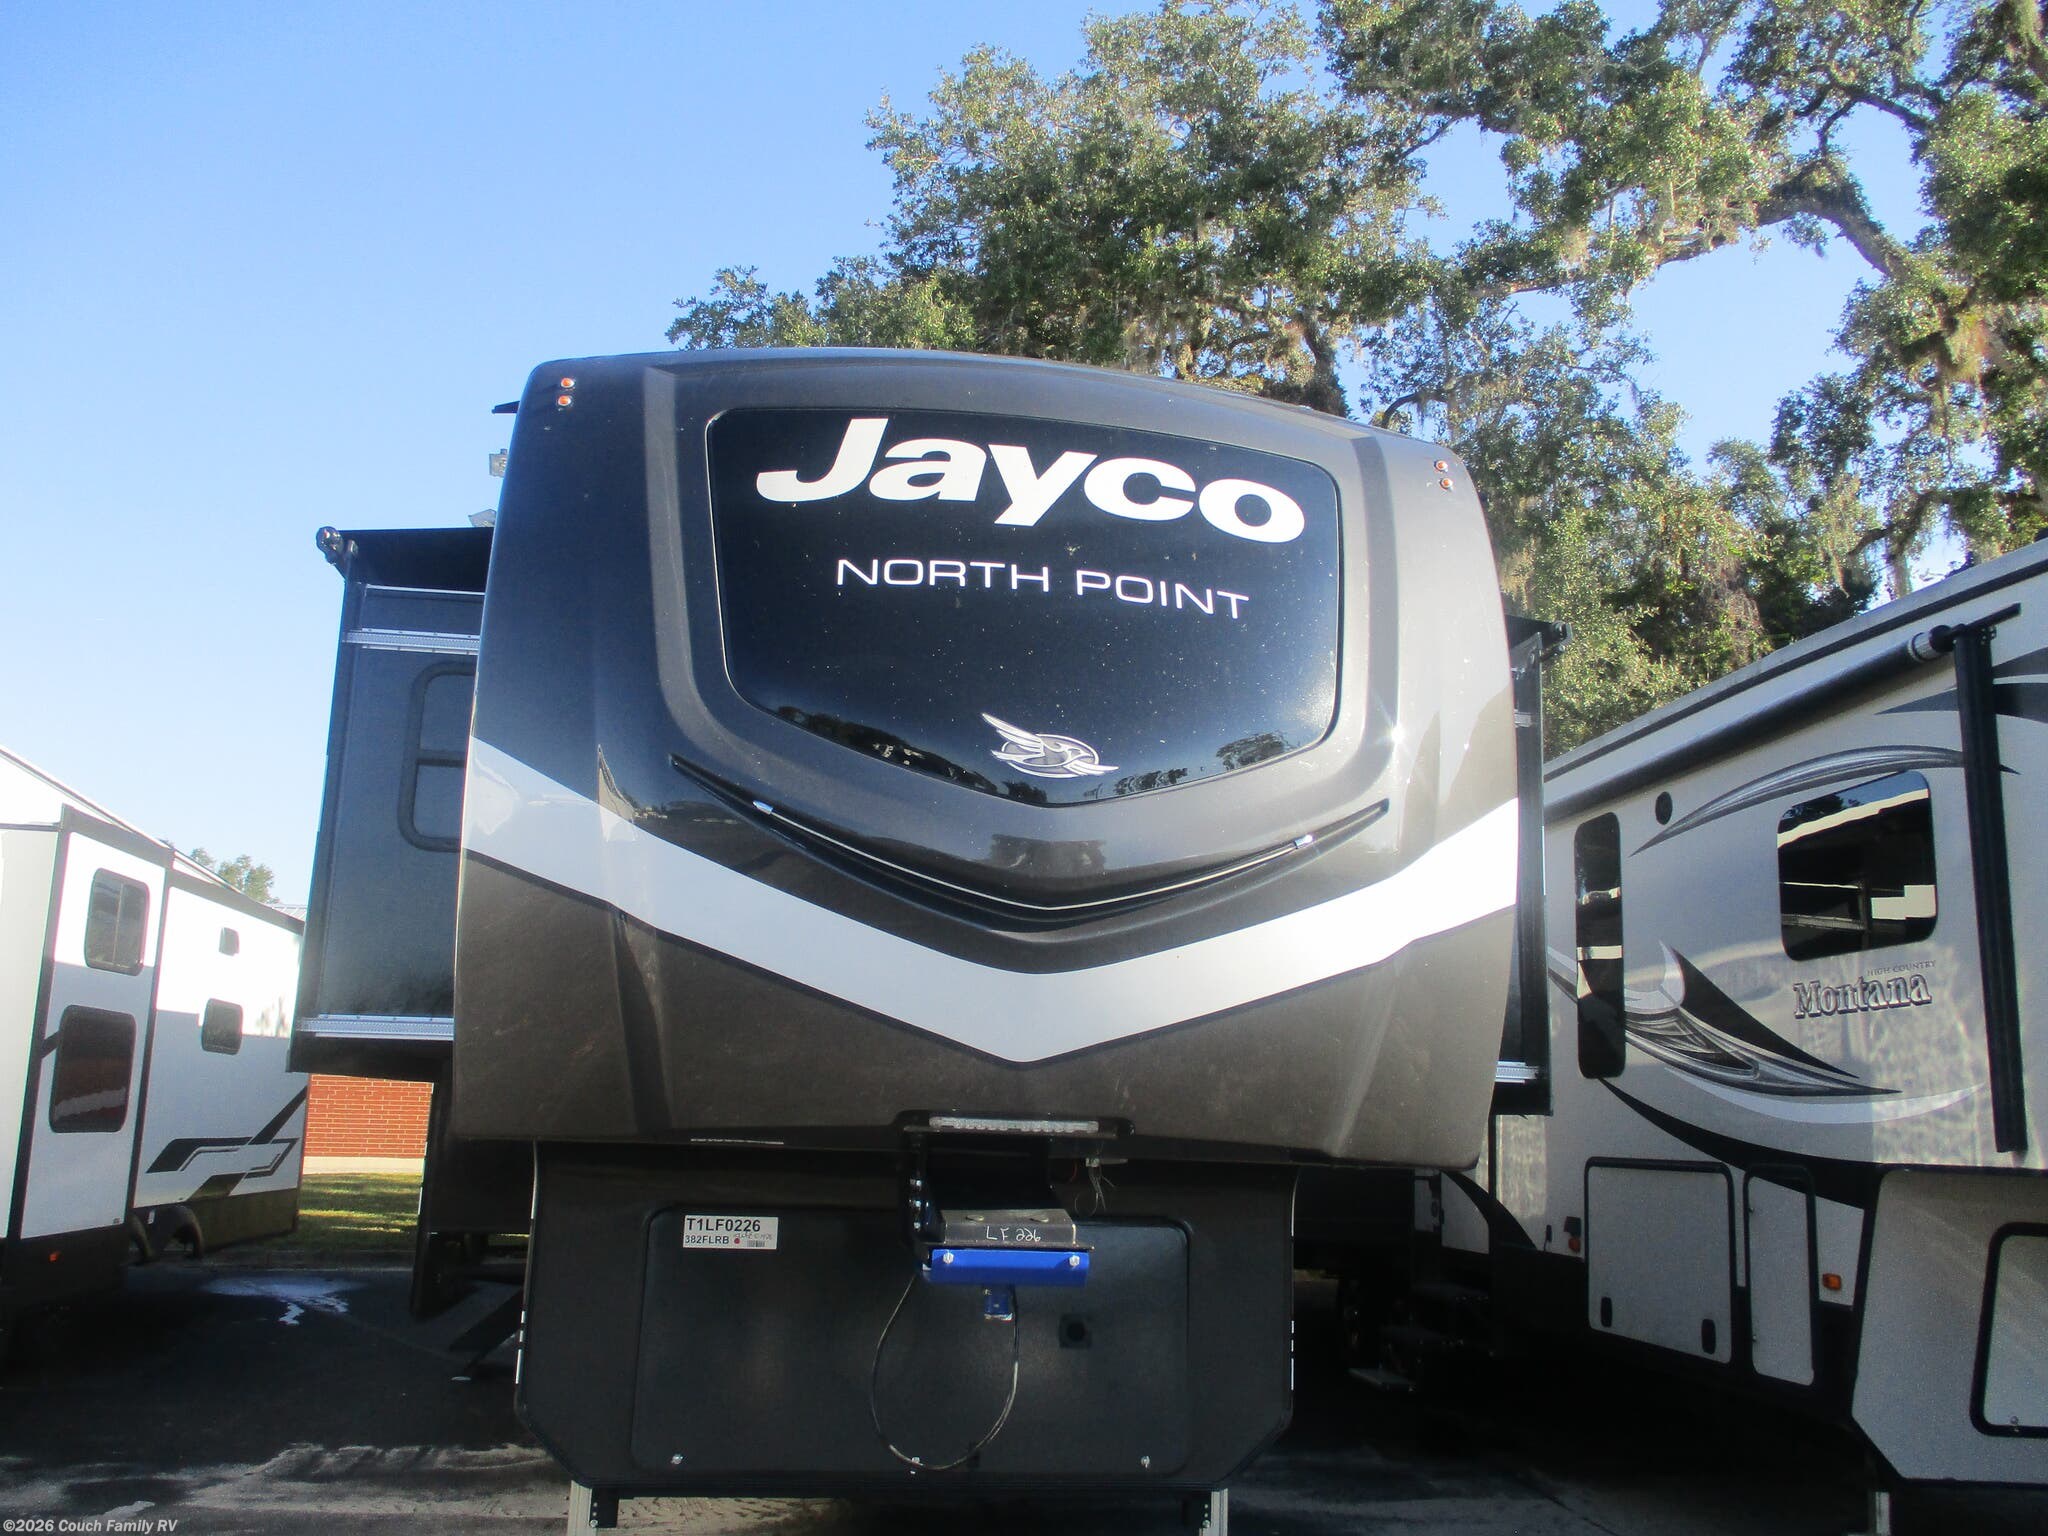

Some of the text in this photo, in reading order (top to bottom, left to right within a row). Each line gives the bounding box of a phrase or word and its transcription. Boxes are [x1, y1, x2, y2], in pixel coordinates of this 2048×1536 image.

[756, 418, 1305, 543] Jayco
[836, 558, 1250, 620] NORTH POINT
[1867, 960, 1936, 977] HIGH COUNTRY
[1793, 973, 1933, 1019] Montana
[684, 1235, 730, 1244] 382FLRB
[686, 1218, 761, 1232] T1LF0226
